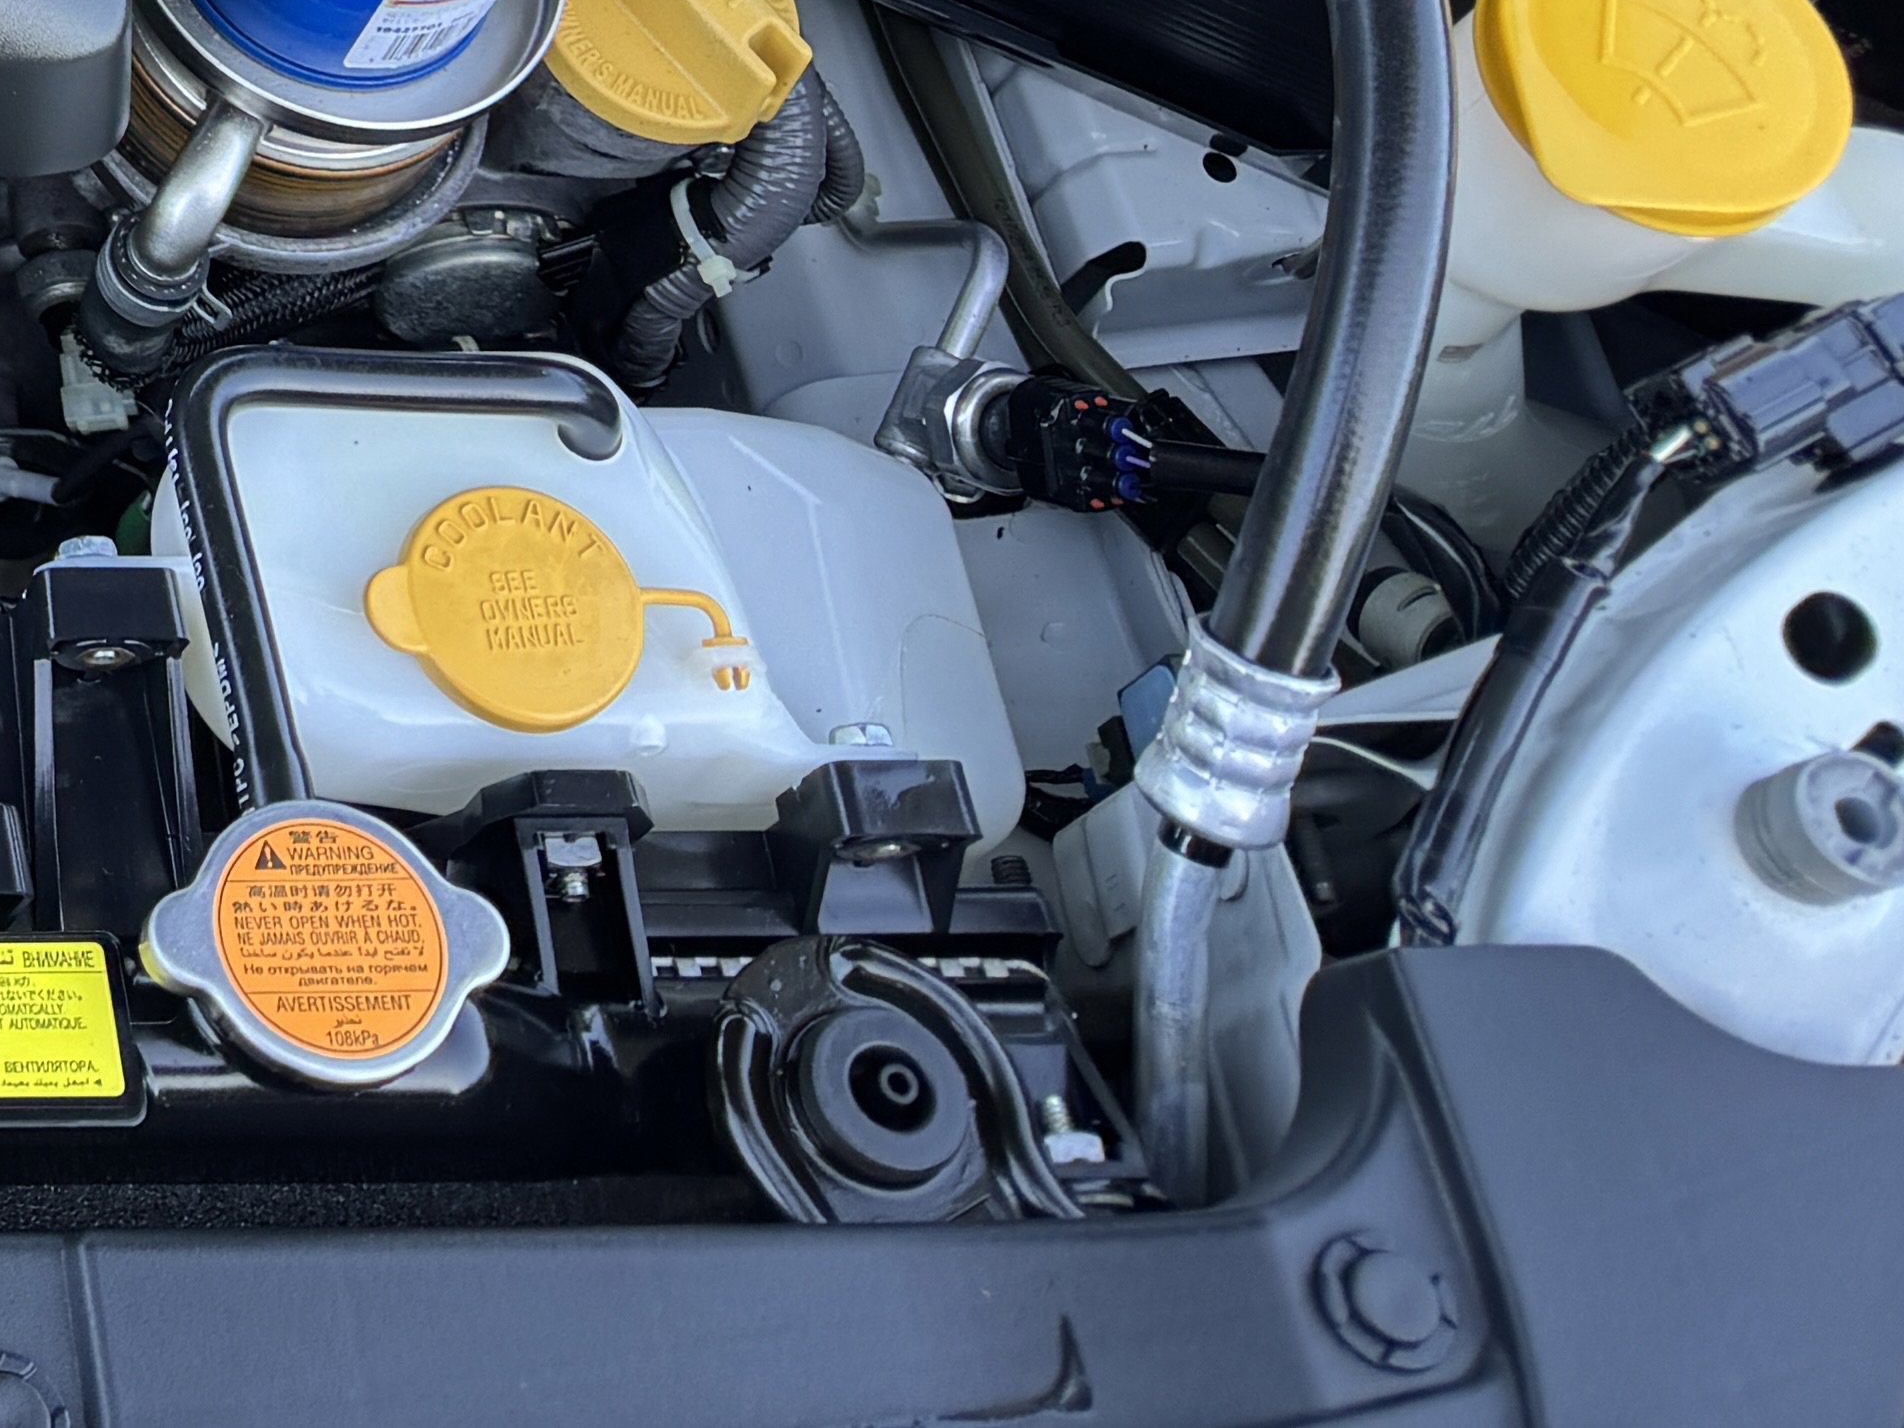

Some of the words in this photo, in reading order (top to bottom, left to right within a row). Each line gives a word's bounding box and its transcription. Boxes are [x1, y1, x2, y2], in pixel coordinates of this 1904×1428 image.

[611, 73, 703, 119] MANUAL
[420, 496, 605, 572] COOLANT
[488, 569, 541, 593] SEE
[479, 595, 578, 622] OWNERS
[485, 623, 584, 651] MANUAL
[286, 845, 374, 861] WARNING
[289, 862, 399, 877] ПРЕДУПРЕЖДЕНИЕ
[246, 884, 397, 898] 高温时请勿打开
[234, 915, 283, 930] NEVER
[289, 914, 329, 929] OPEN
[334, 914, 381, 929] WHEN
[387, 914, 422, 929] HOT.
[236, 931, 253, 946] NE
[259, 931, 304, 946] JAMAIS
[310, 931, 358, 945] OUVRIR
[377, 930, 424, 944] CHAUD.
[22, 949, 95, 969] ВНИМАНИЕ
[243, 964, 263, 975] Не
[268, 964, 342, 977] открывать
[347, 964, 363, 974] на
[367, 963, 428, 976] горячем
[275, 994, 412, 1013] AVERTISSEMENT
[325, 1030, 379, 1048] 108kPa
